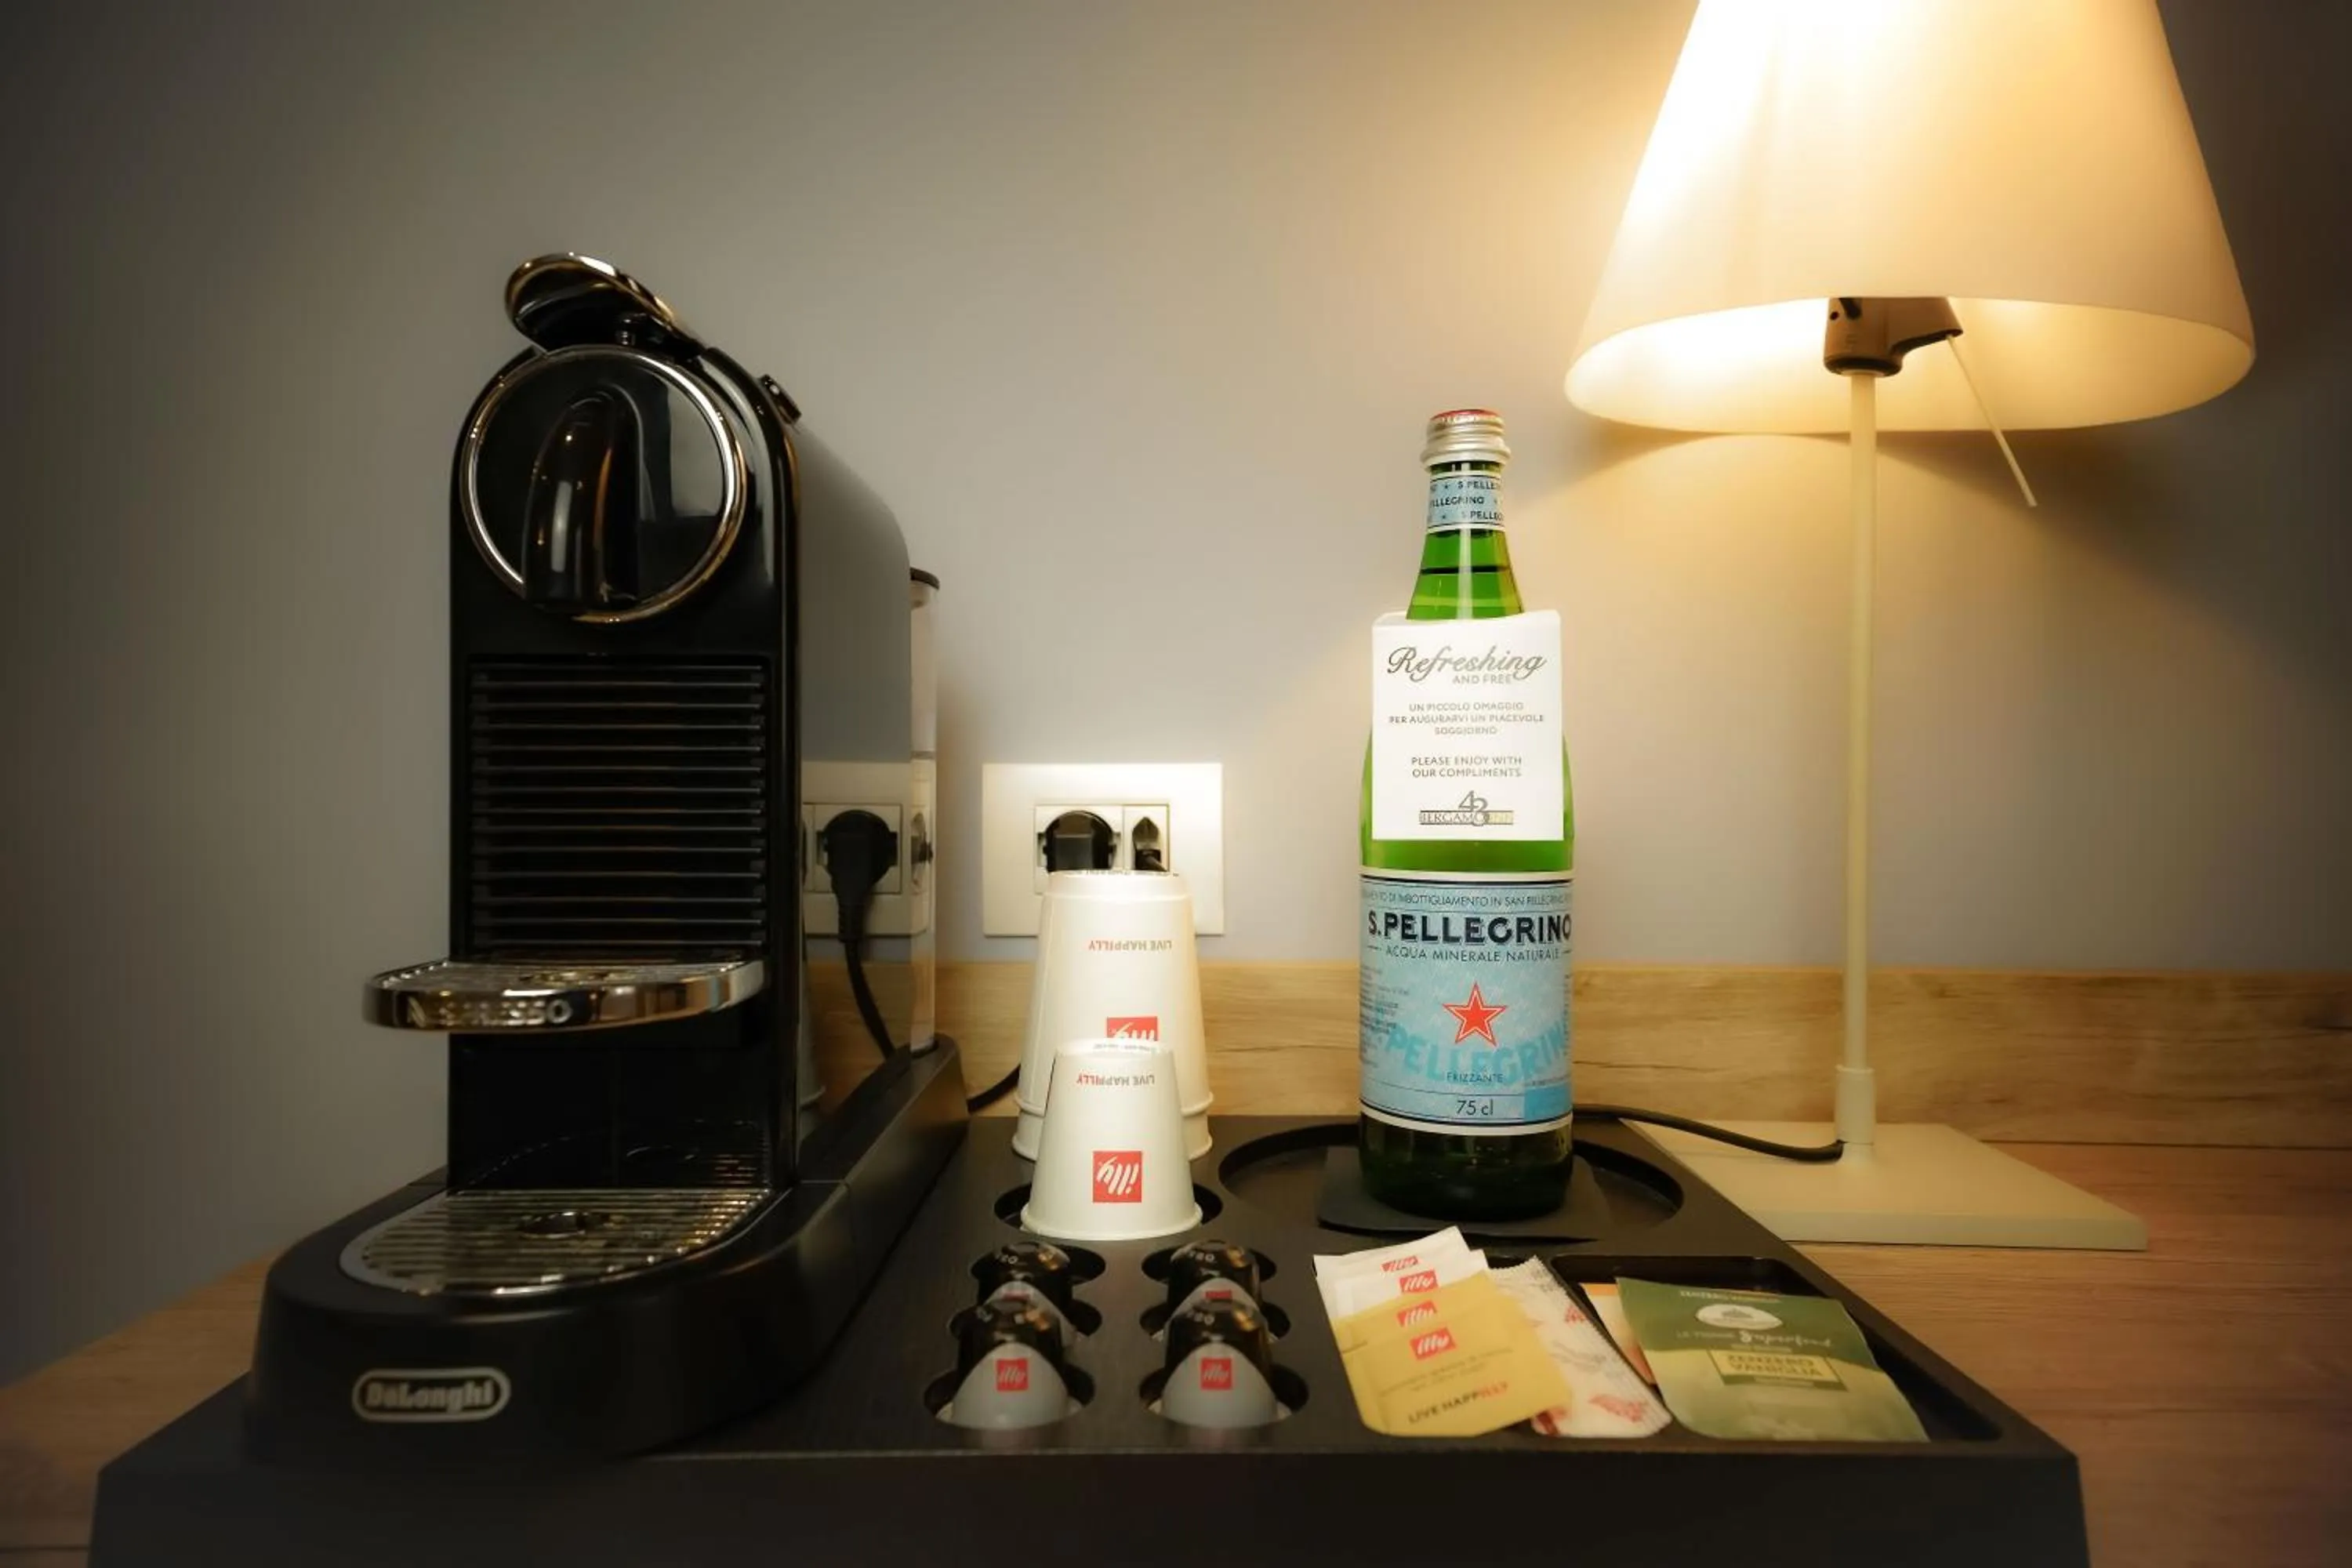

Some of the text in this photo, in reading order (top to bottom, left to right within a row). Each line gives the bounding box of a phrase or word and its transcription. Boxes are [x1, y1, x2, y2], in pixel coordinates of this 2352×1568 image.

[1387, 645, 1548, 682] Refreshing
[1453, 674, 1512, 684] AND FREE
[1426, 703, 1470, 712] PICCOLO
[1473, 702, 1524, 711] OMAGGIO
[1410, 715, 1468, 724] AUGURARVI
[1471, 714, 1486, 723] UN
[1490, 713, 1544, 722] PIACEVOLE
[1435, 727, 1497, 735] SOGGIORNO
[1411, 756, 1522, 766] PLEASE ENJOY WITH
[1412, 768, 1523, 778] OUR COMPLIMENTS
[1368, 909, 1572, 945] S.PELLEGRINO
[1088, 940, 1172, 951] LIVE HAPPILLY
[1385, 946, 1559, 962] ACQUA MINERALE NATURALE
[1133, 1074, 1155, 1085] LIVE
[1446, 1072, 1504, 1083] FRIZZANTE
[1456, 1099, 1494, 1116] 75 cl
[1096, 1155, 1140, 1196] illy
